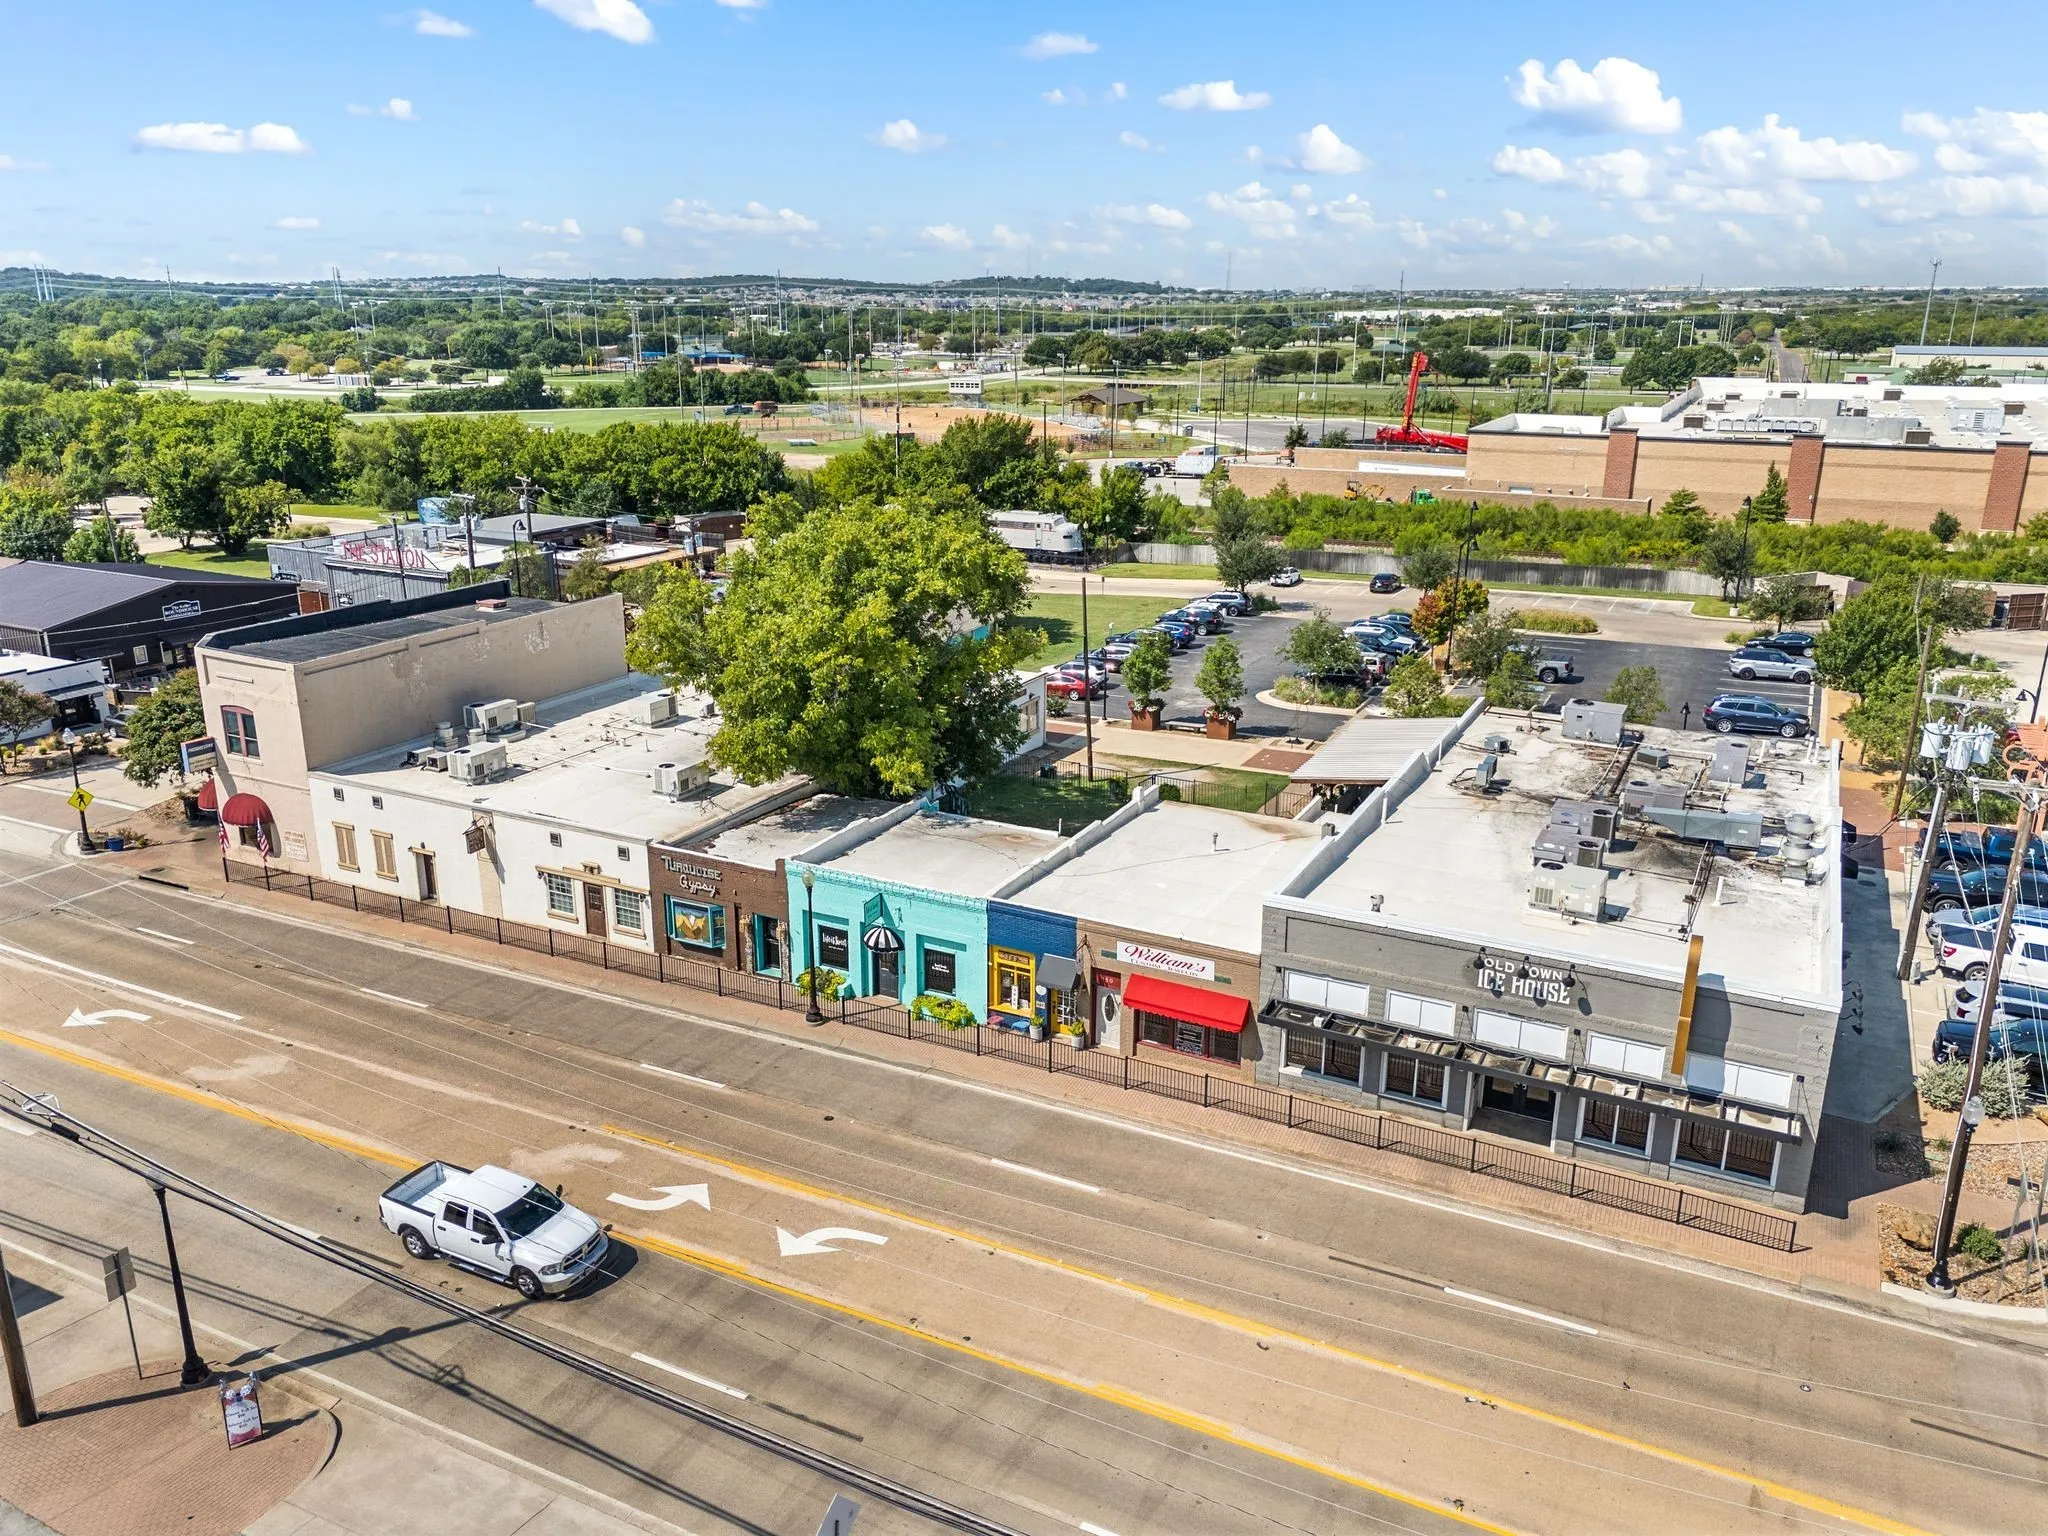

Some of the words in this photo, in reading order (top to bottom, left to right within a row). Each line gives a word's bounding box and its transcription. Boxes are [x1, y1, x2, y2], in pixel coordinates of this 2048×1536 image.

[342, 541, 367, 562] THE
[661, 855, 722, 881] TURQUOISE
[679, 874, 716, 898] Gypsy
[1124, 945, 1206, 973] William's
[1484, 957, 1515, 973] OLD
[1477, 968, 1506, 992] ICE
[1511, 975, 1571, 1005] HOUSE
